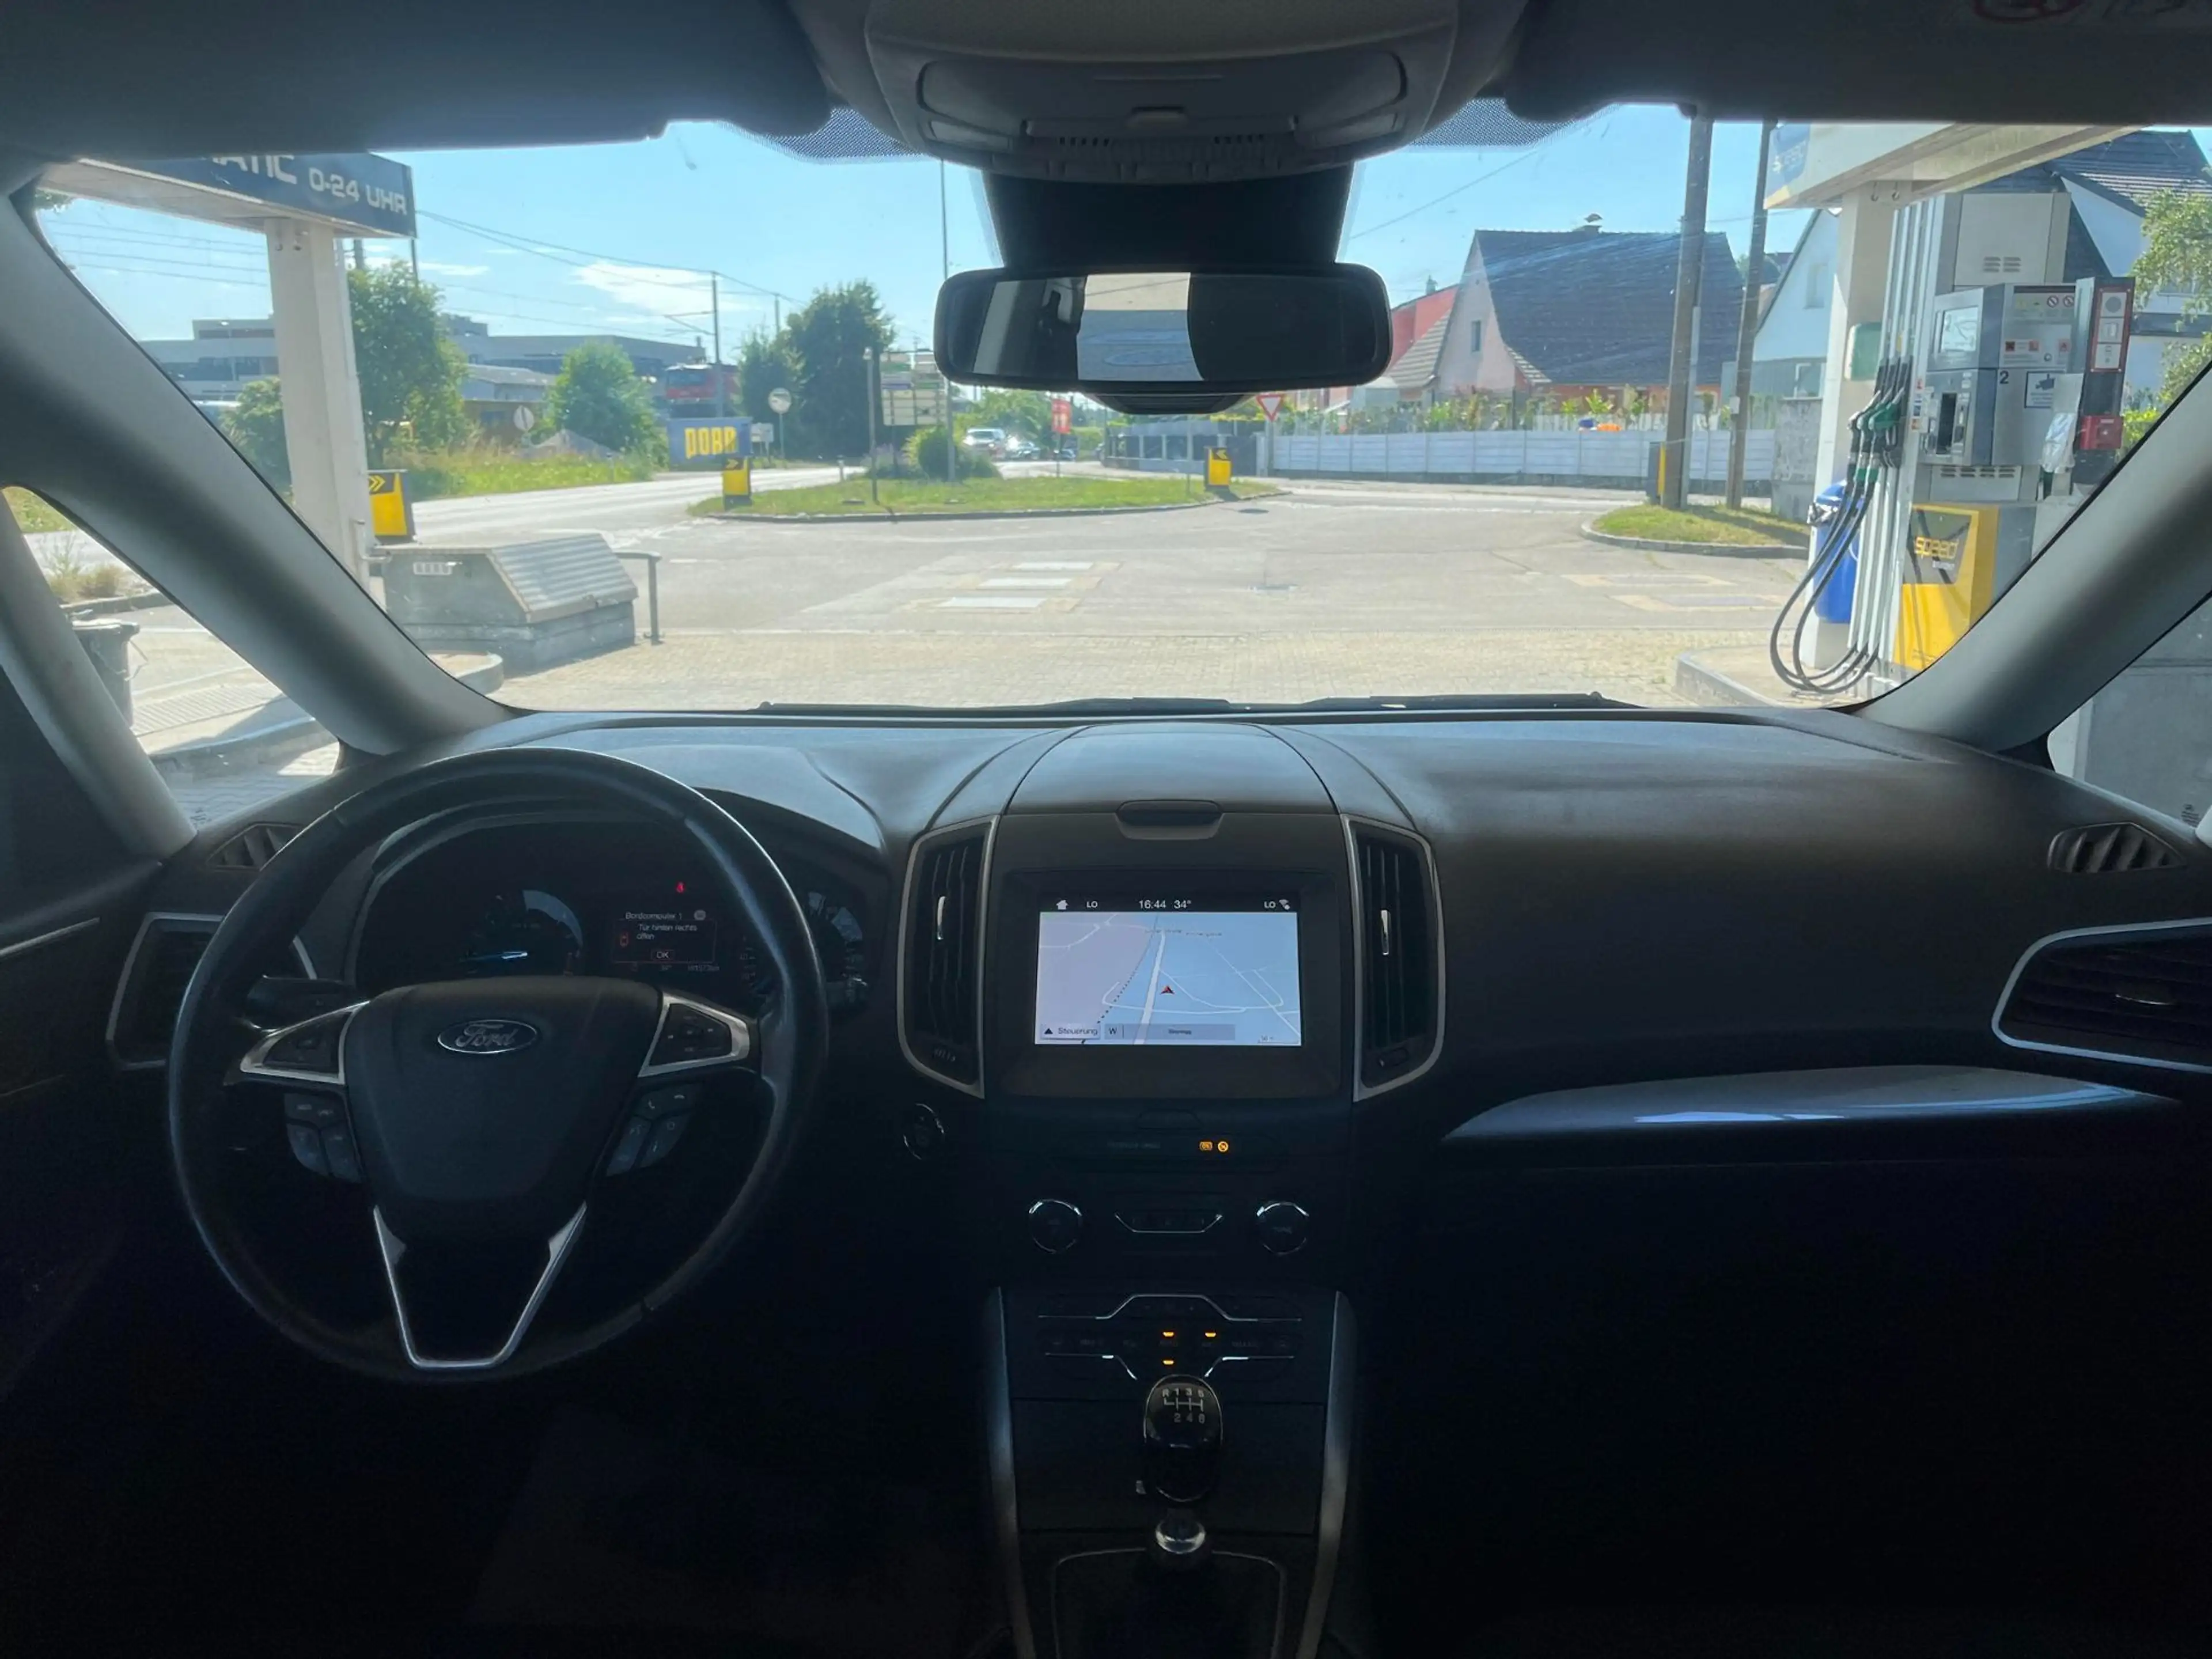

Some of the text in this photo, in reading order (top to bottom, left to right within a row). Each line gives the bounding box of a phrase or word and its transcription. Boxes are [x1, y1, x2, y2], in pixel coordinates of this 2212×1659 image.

[309, 168, 359, 202] 0-24
[365, 184, 407, 215] UHR
[1999, 370, 2009, 384] 2
[1139, 900, 1166, 909] 16:44
[1174, 900, 1191, 908] 34°
[455, 1024, 518, 1047] Ford
[1058, 1027, 1098, 1036] Steuerung
[1174, 1412, 1181, 1423] 2
